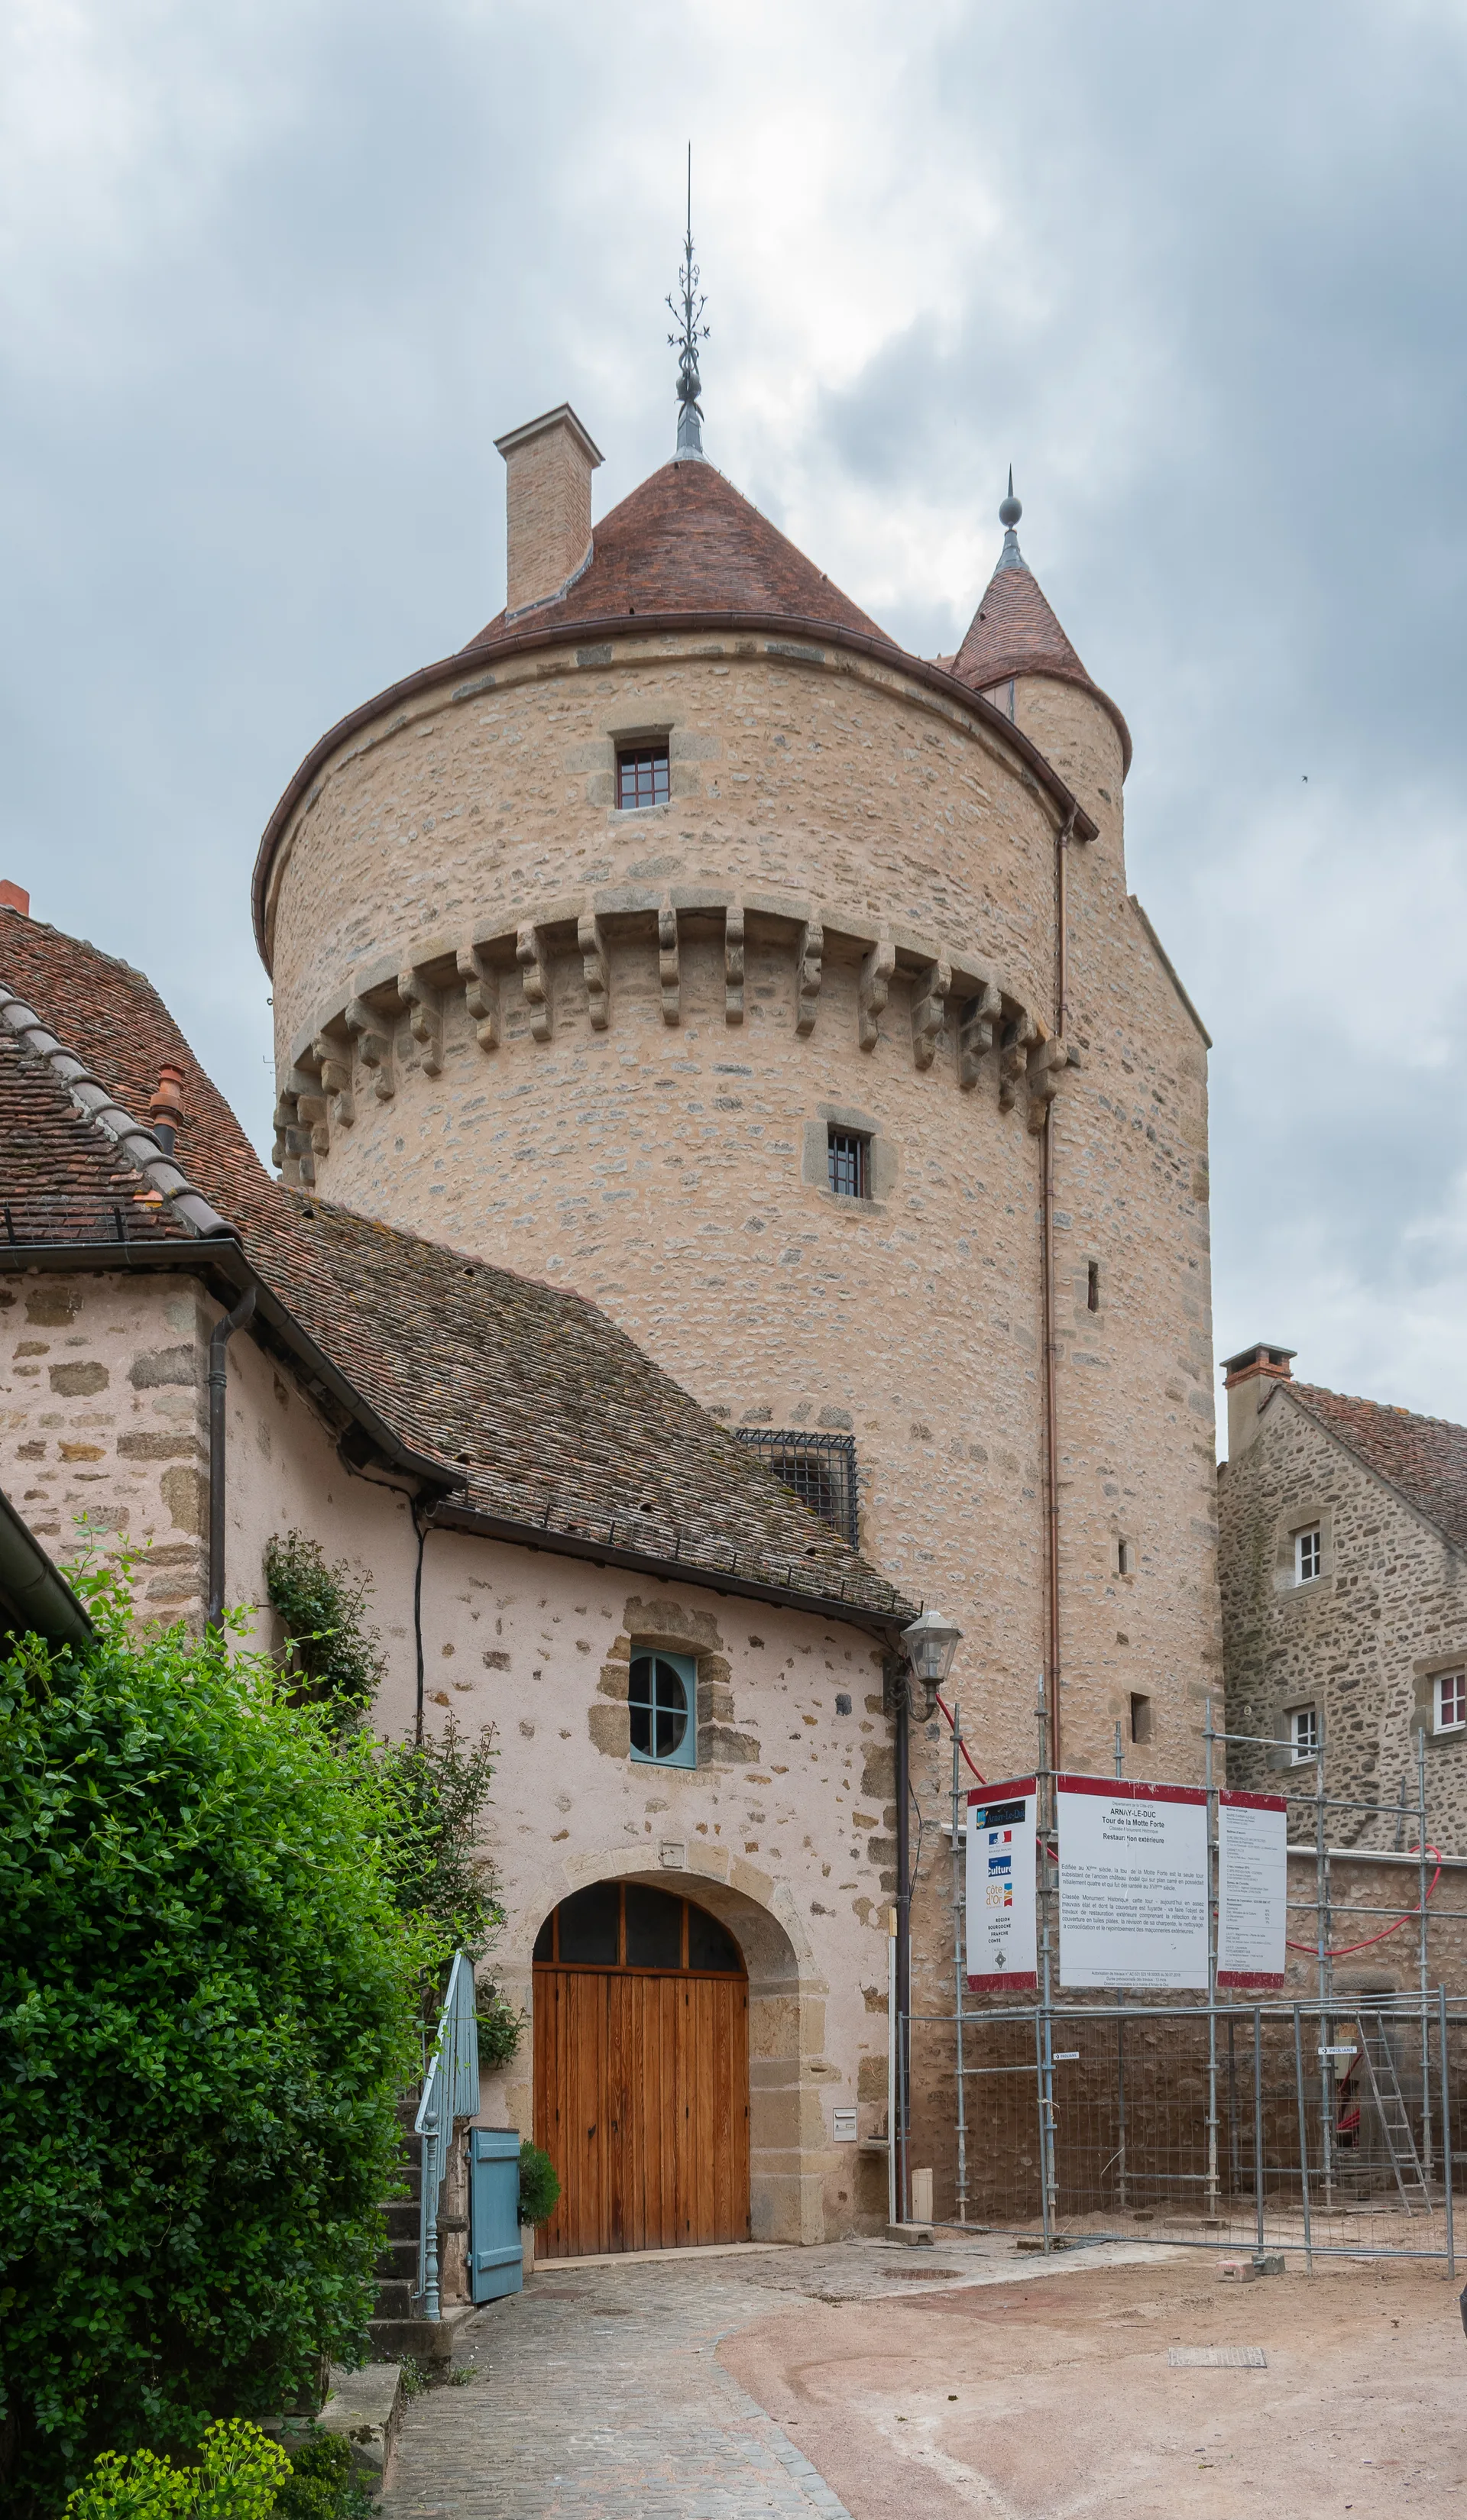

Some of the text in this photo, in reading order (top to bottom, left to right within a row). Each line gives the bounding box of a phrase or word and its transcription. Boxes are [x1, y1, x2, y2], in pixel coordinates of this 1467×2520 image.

[1110, 1808, 1156, 1818] ARNAY-LE-DUC
[986, 1885, 1002, 1894] Côte
[986, 1894, 1002, 1905] d'Or
